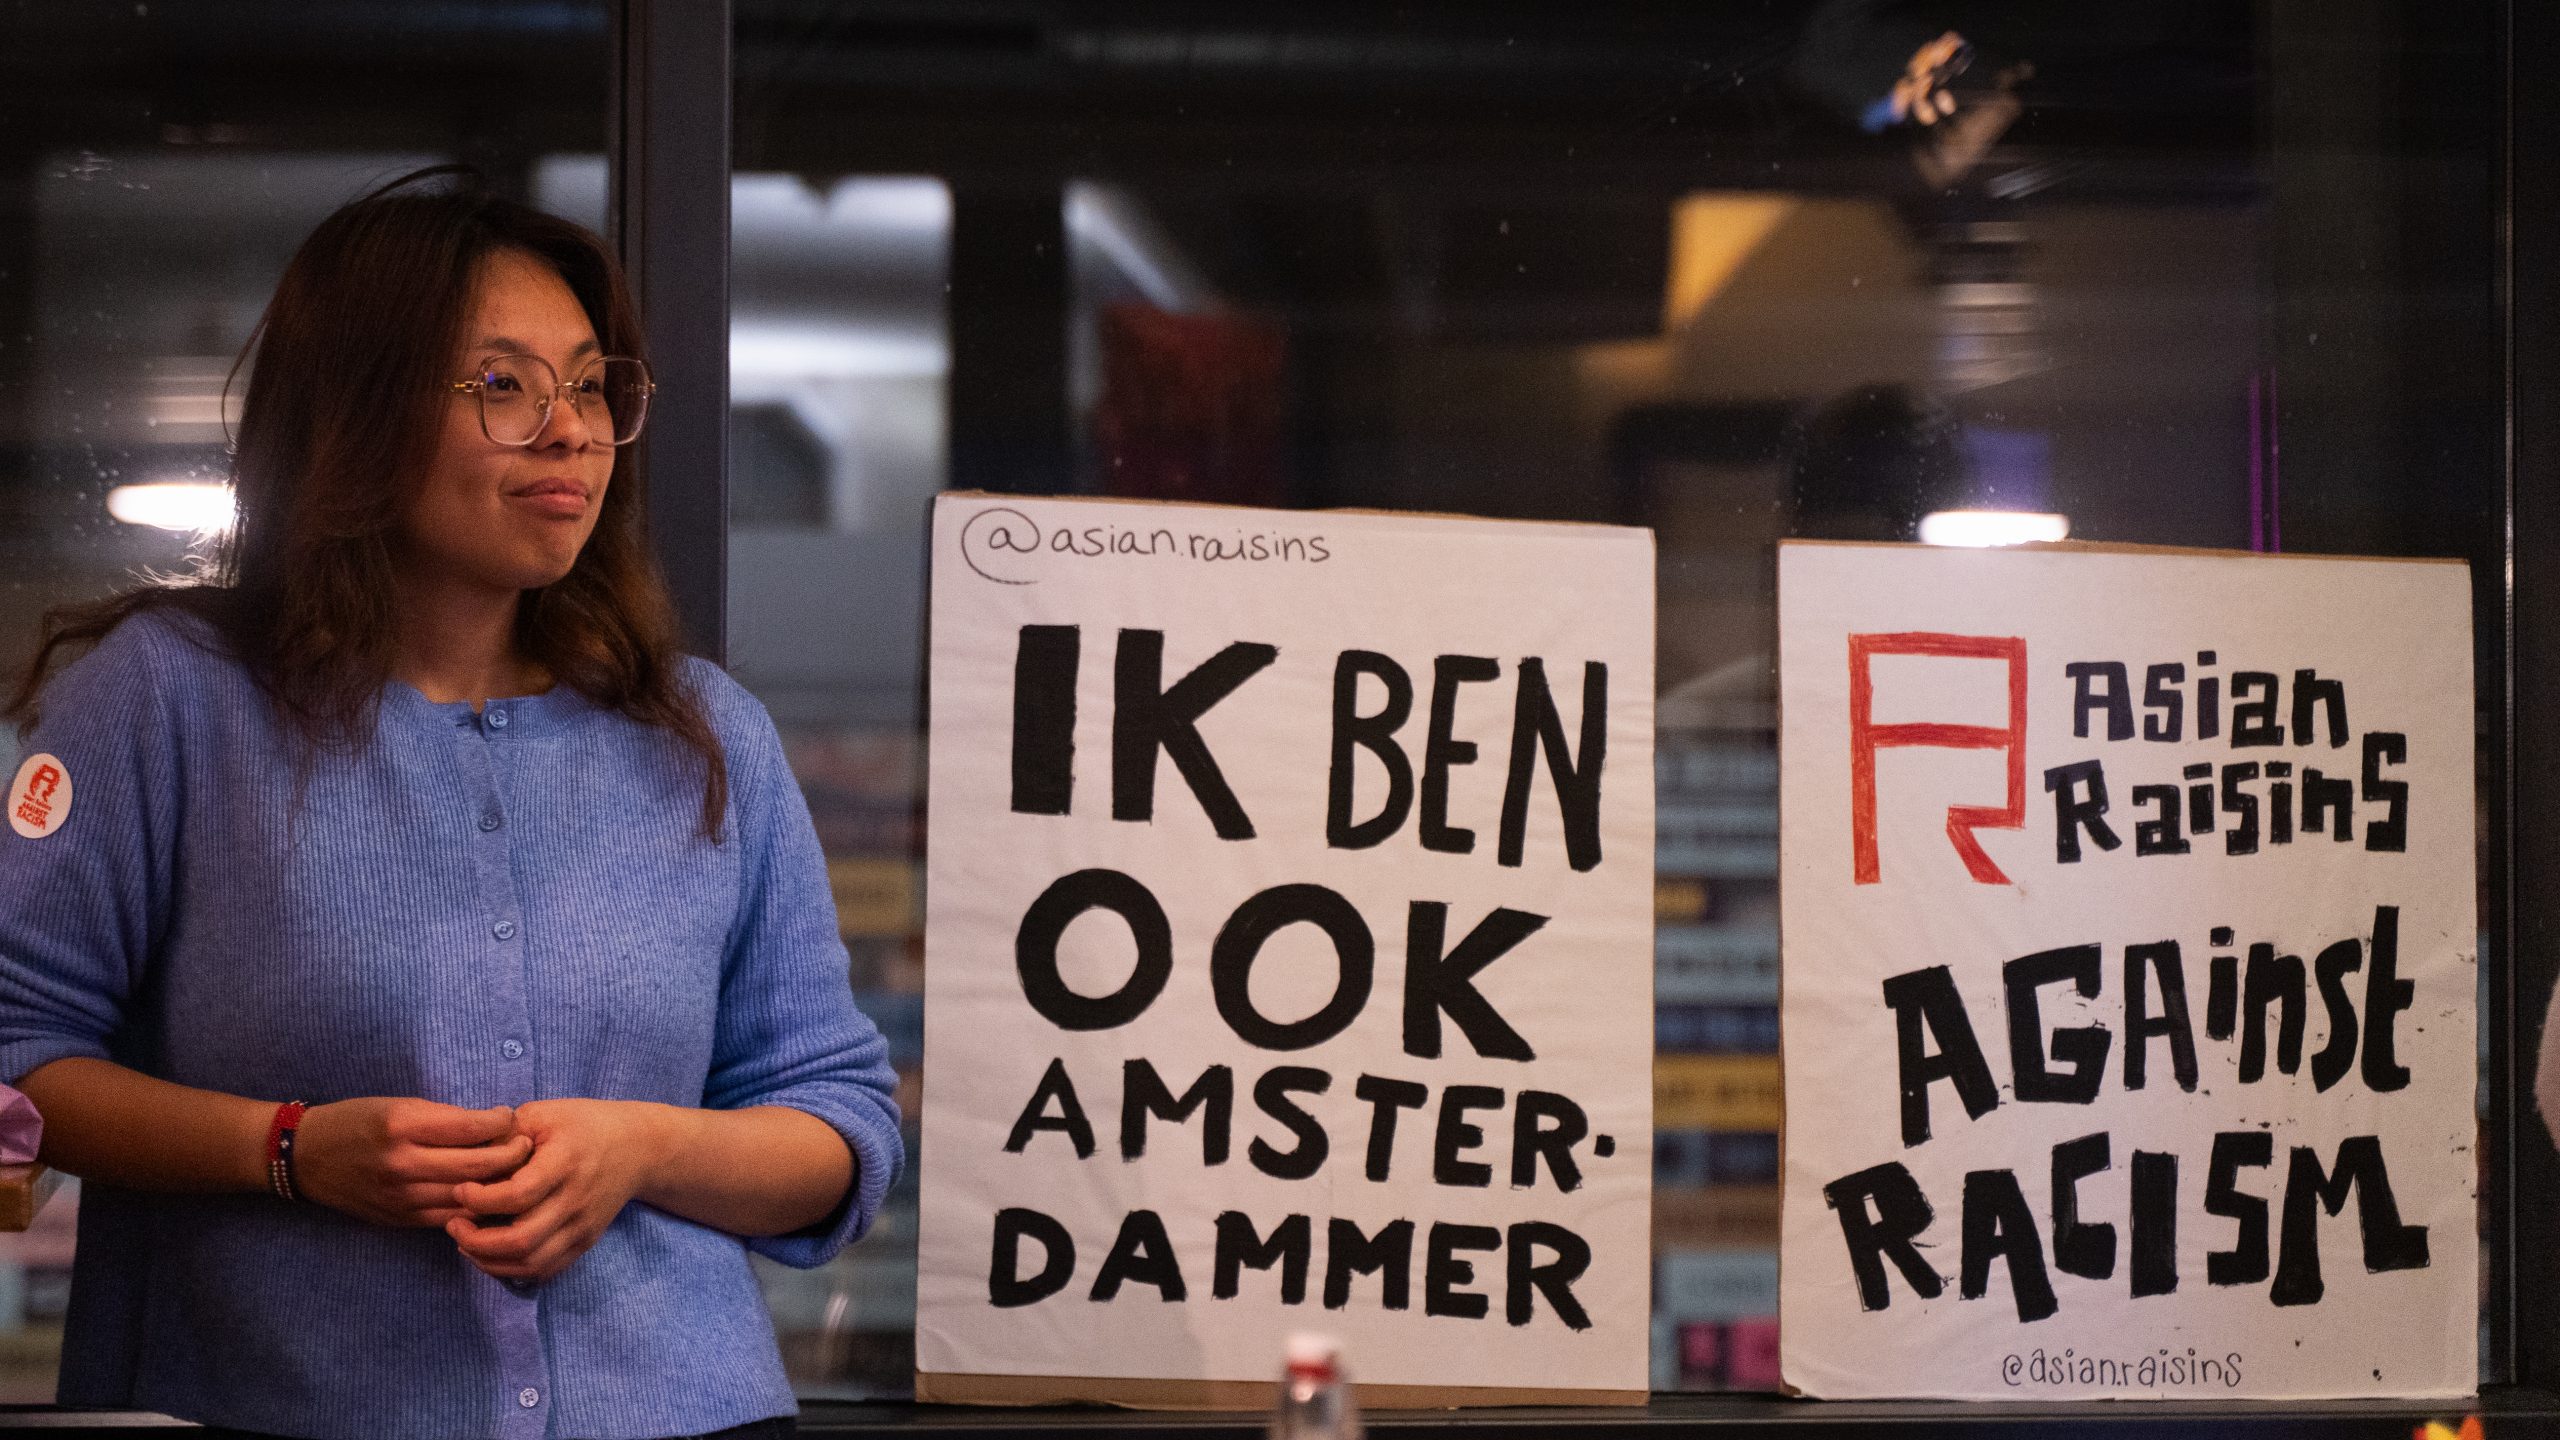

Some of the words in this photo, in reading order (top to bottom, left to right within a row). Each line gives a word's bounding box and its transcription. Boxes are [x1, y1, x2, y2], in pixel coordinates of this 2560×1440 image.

[961, 508, 1331, 584] @asian.raisins
[1011, 624, 1280, 841] IK
[1326, 649, 1608, 873] BEN
[2065, 650, 2350, 749] Asian
[2043, 731, 2409, 863] Raisins
[1015, 868, 1552, 1062] OOK
[988, 1207, 1592, 1332] DAMMER
[1822, 1131, 2431, 1323] RACISM
